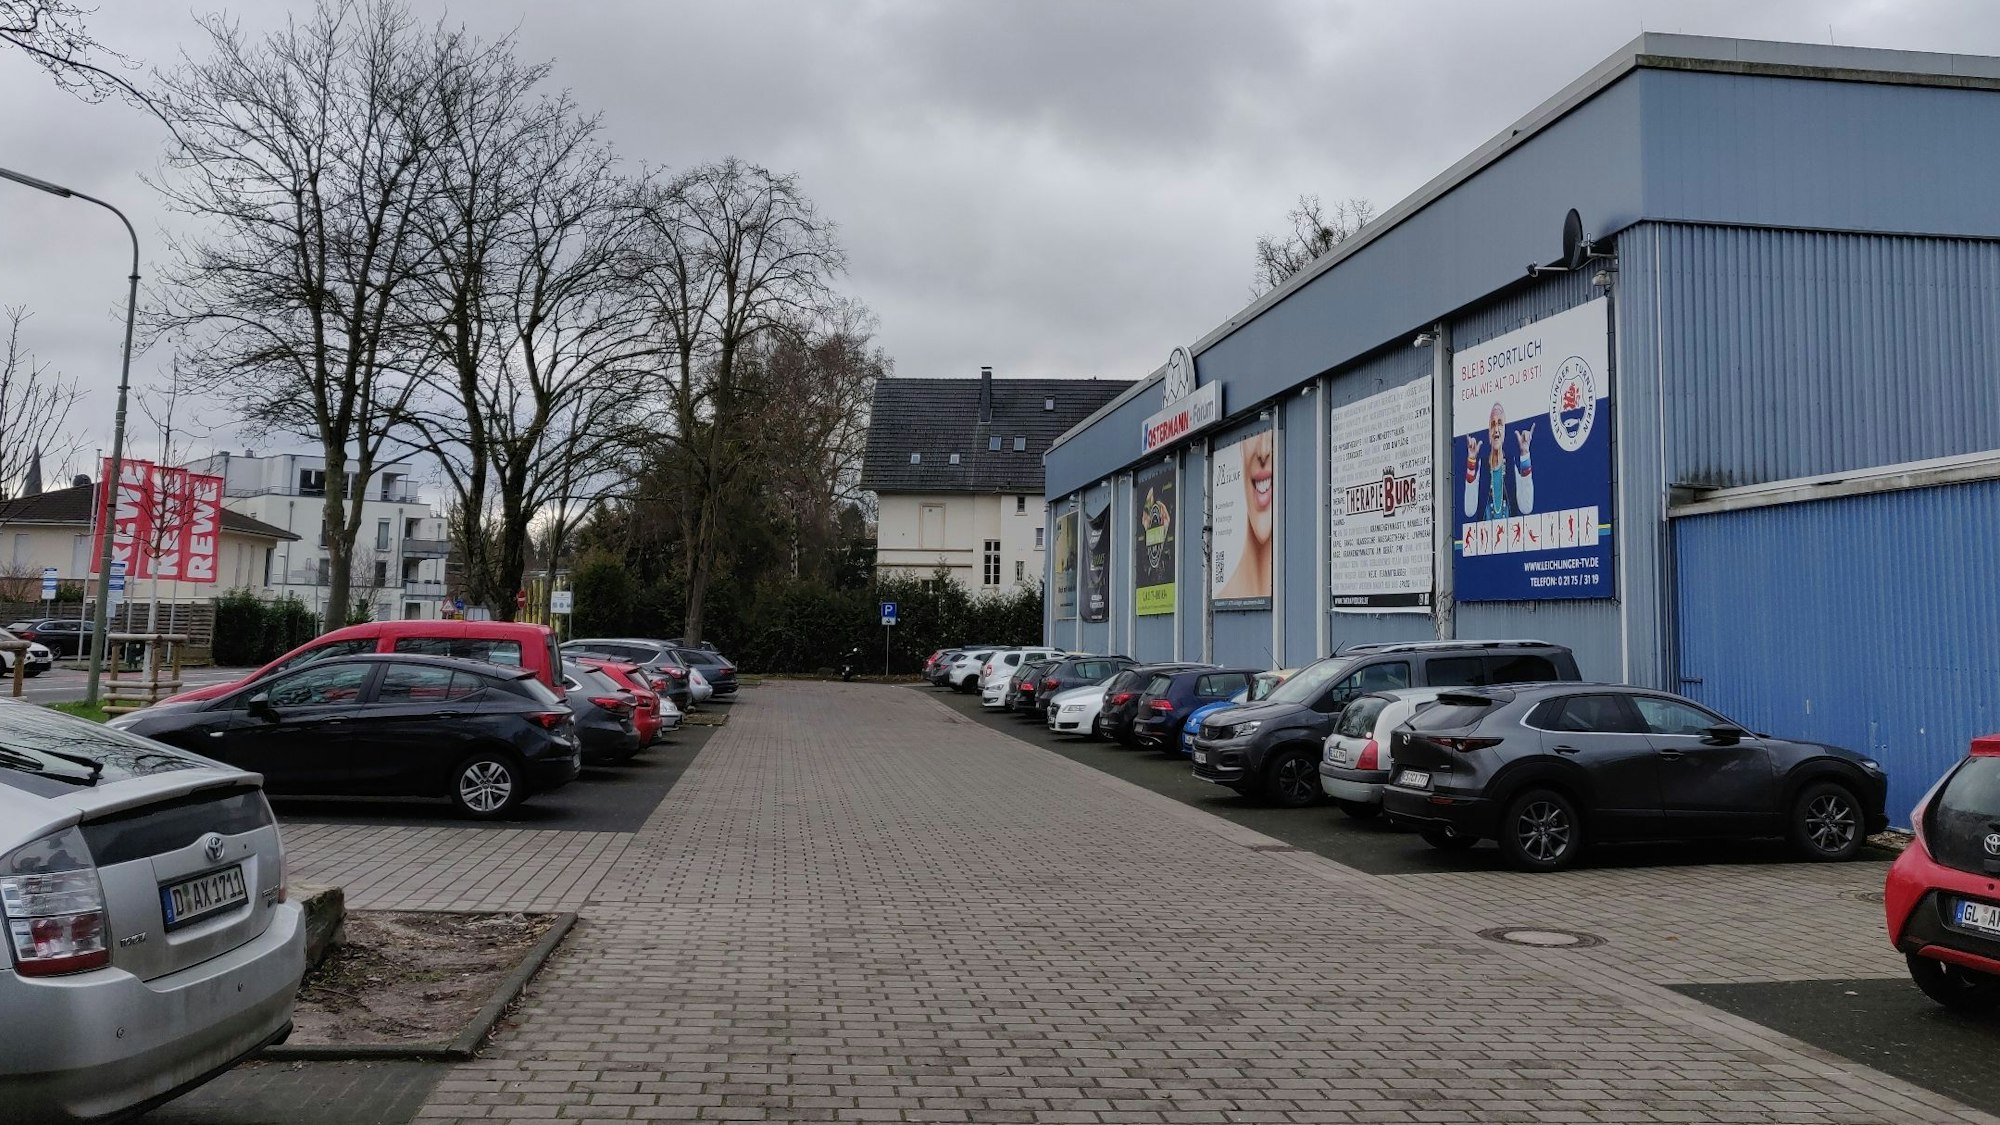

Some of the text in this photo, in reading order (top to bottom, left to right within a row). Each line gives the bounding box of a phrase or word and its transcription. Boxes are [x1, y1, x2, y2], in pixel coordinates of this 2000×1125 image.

[1461, 338, 1542, 381] BLEIB SPORTLICH
[1461, 364, 1542, 401] EGAL WIE ALT DU BIST!
[1551, 363, 1593, 439] LEICHLINGER TURNVEREIN
[1147, 409, 1189, 448] OSTERMANN
[1192, 400, 1214, 425] Forum
[147, 471, 181, 576] REWE
[187, 481, 218, 579] REWE
[1524, 557, 1599, 572] WWW.LEICHLINGER-TV.DE
[1530, 576, 1557, 587] TELEFON:
[172, 888, 184, 916] D
[193, 880, 212, 910] AX
[212, 871, 244, 903] 1711
[1964, 904, 1979, 923] GL
